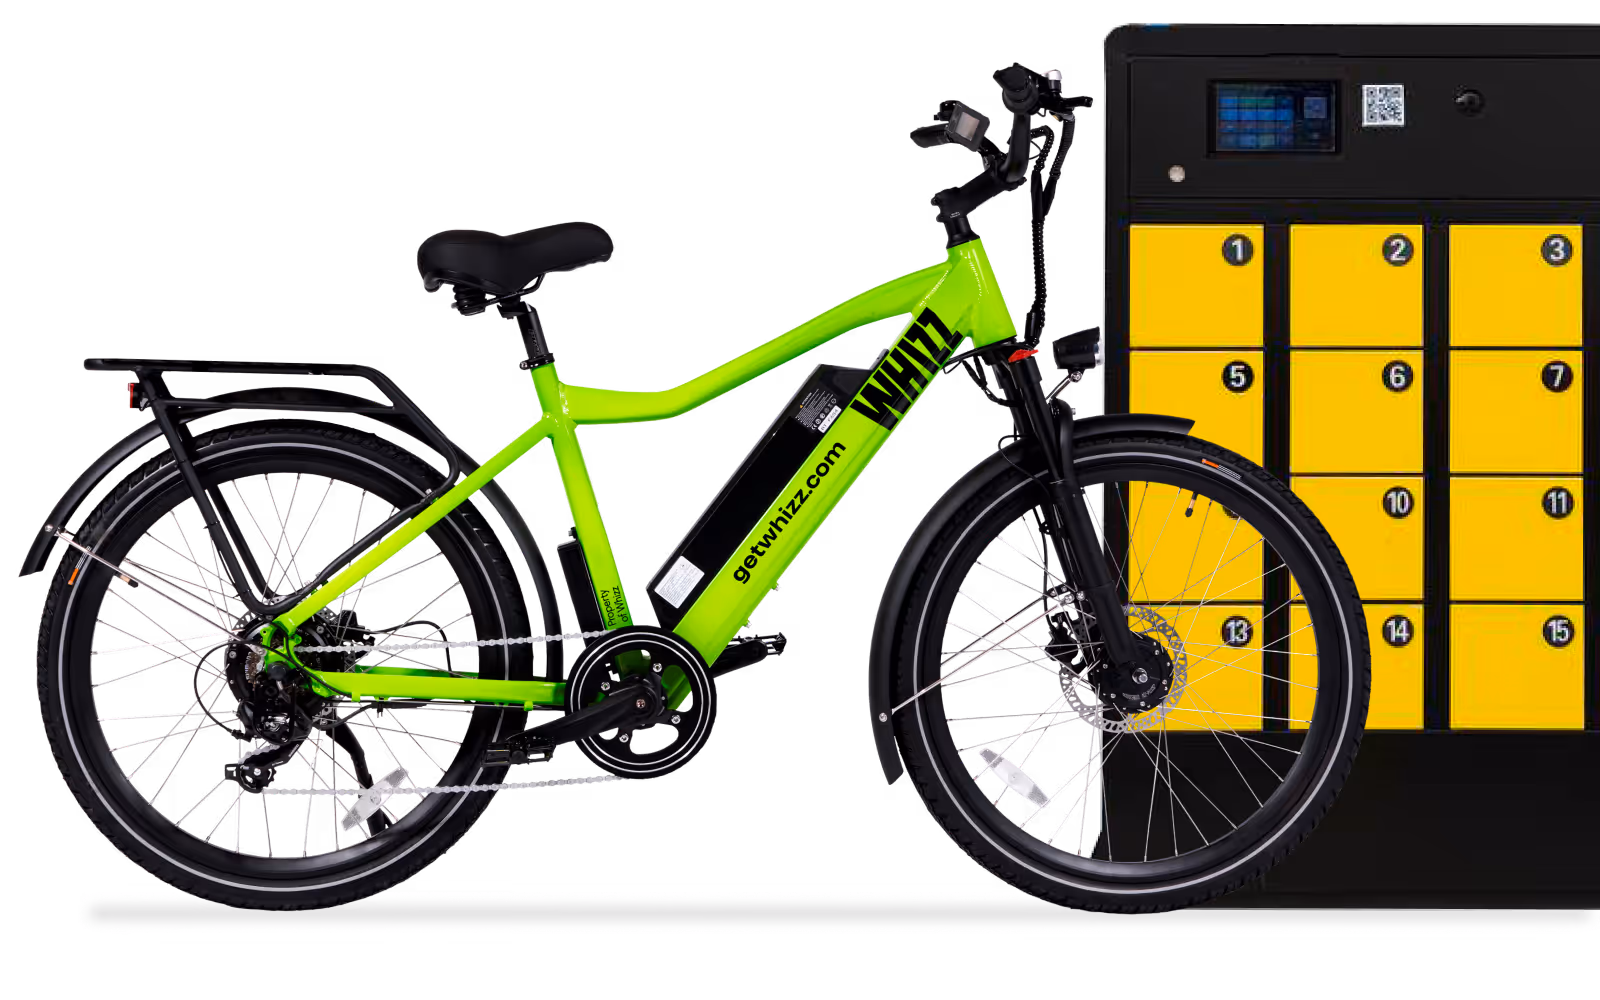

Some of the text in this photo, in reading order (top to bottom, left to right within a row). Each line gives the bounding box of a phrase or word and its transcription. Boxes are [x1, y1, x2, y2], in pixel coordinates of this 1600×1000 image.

[1231, 238, 1244, 261] 1
[1390, 238, 1406, 262] 2
[1550, 238, 1565, 261] 3
[849, 306, 964, 431] WHIZZ
[1230, 365, 1245, 387] 5
[1389, 365, 1406, 388] 6
[1550, 364, 1564, 387] 7
[733, 442, 847, 584] getwhizz.com
[1386, 491, 1409, 514] 10
[1547, 491, 1568, 514] 11
[600, 590, 617, 627] Property
[612, 586, 629, 622] of Whizz
[1225, 619, 1248, 642] 13
[1386, 619, 1410, 643] 14
[1547, 619, 1569, 643] 15
